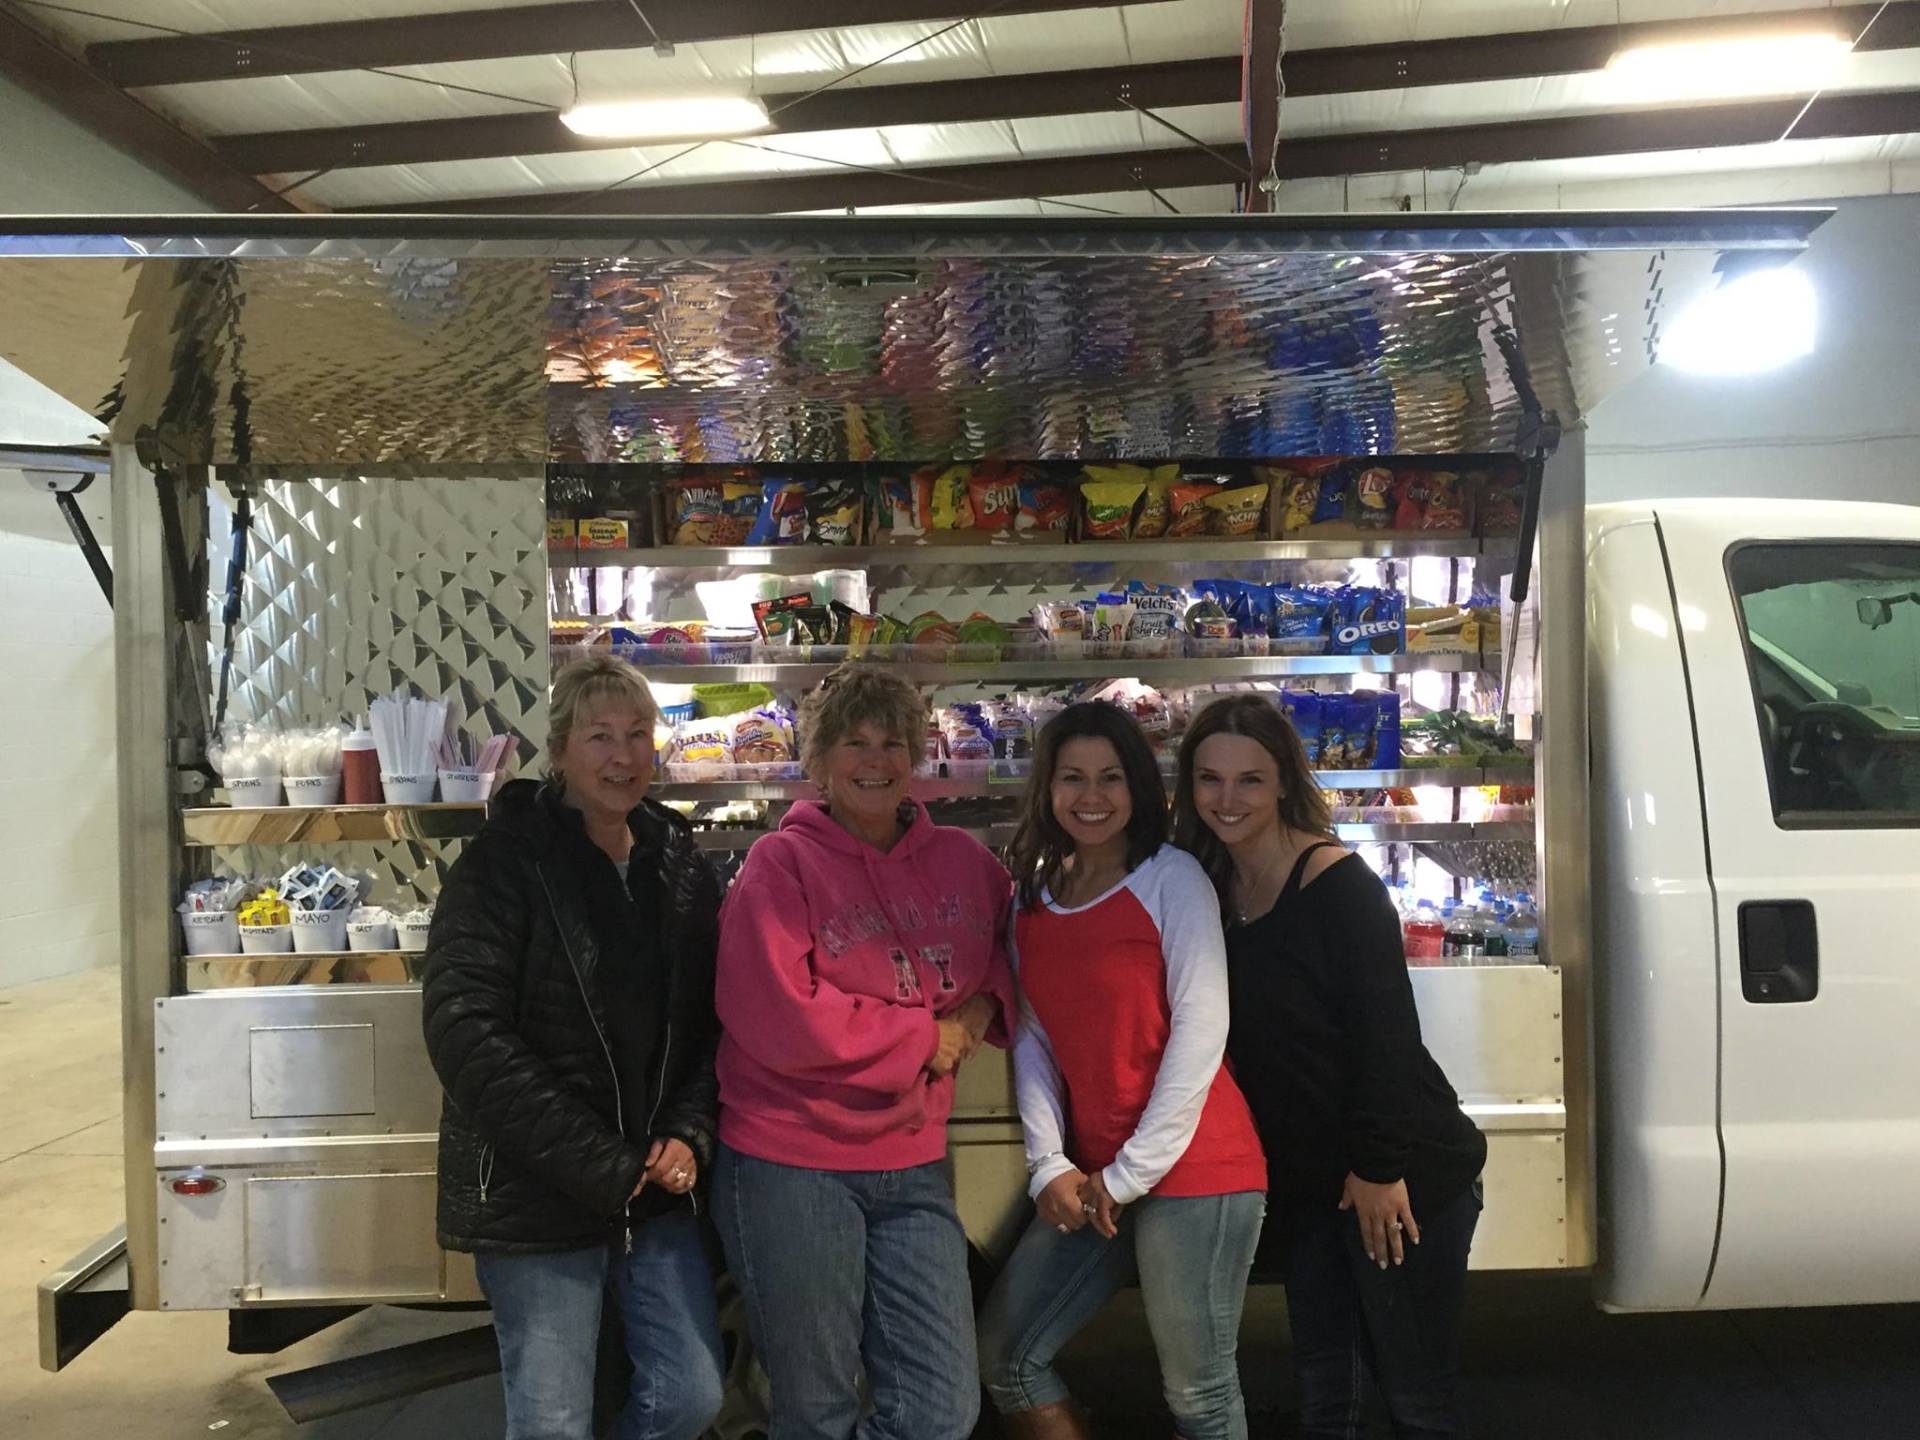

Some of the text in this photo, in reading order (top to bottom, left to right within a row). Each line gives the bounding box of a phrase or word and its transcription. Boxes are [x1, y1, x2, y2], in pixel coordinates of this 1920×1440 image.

[1129, 596, 1174, 610] Welch's
[1338, 620, 1400, 644] OREO
[295, 778, 322, 788] FORKS
[294, 913, 330, 925] MAYO
